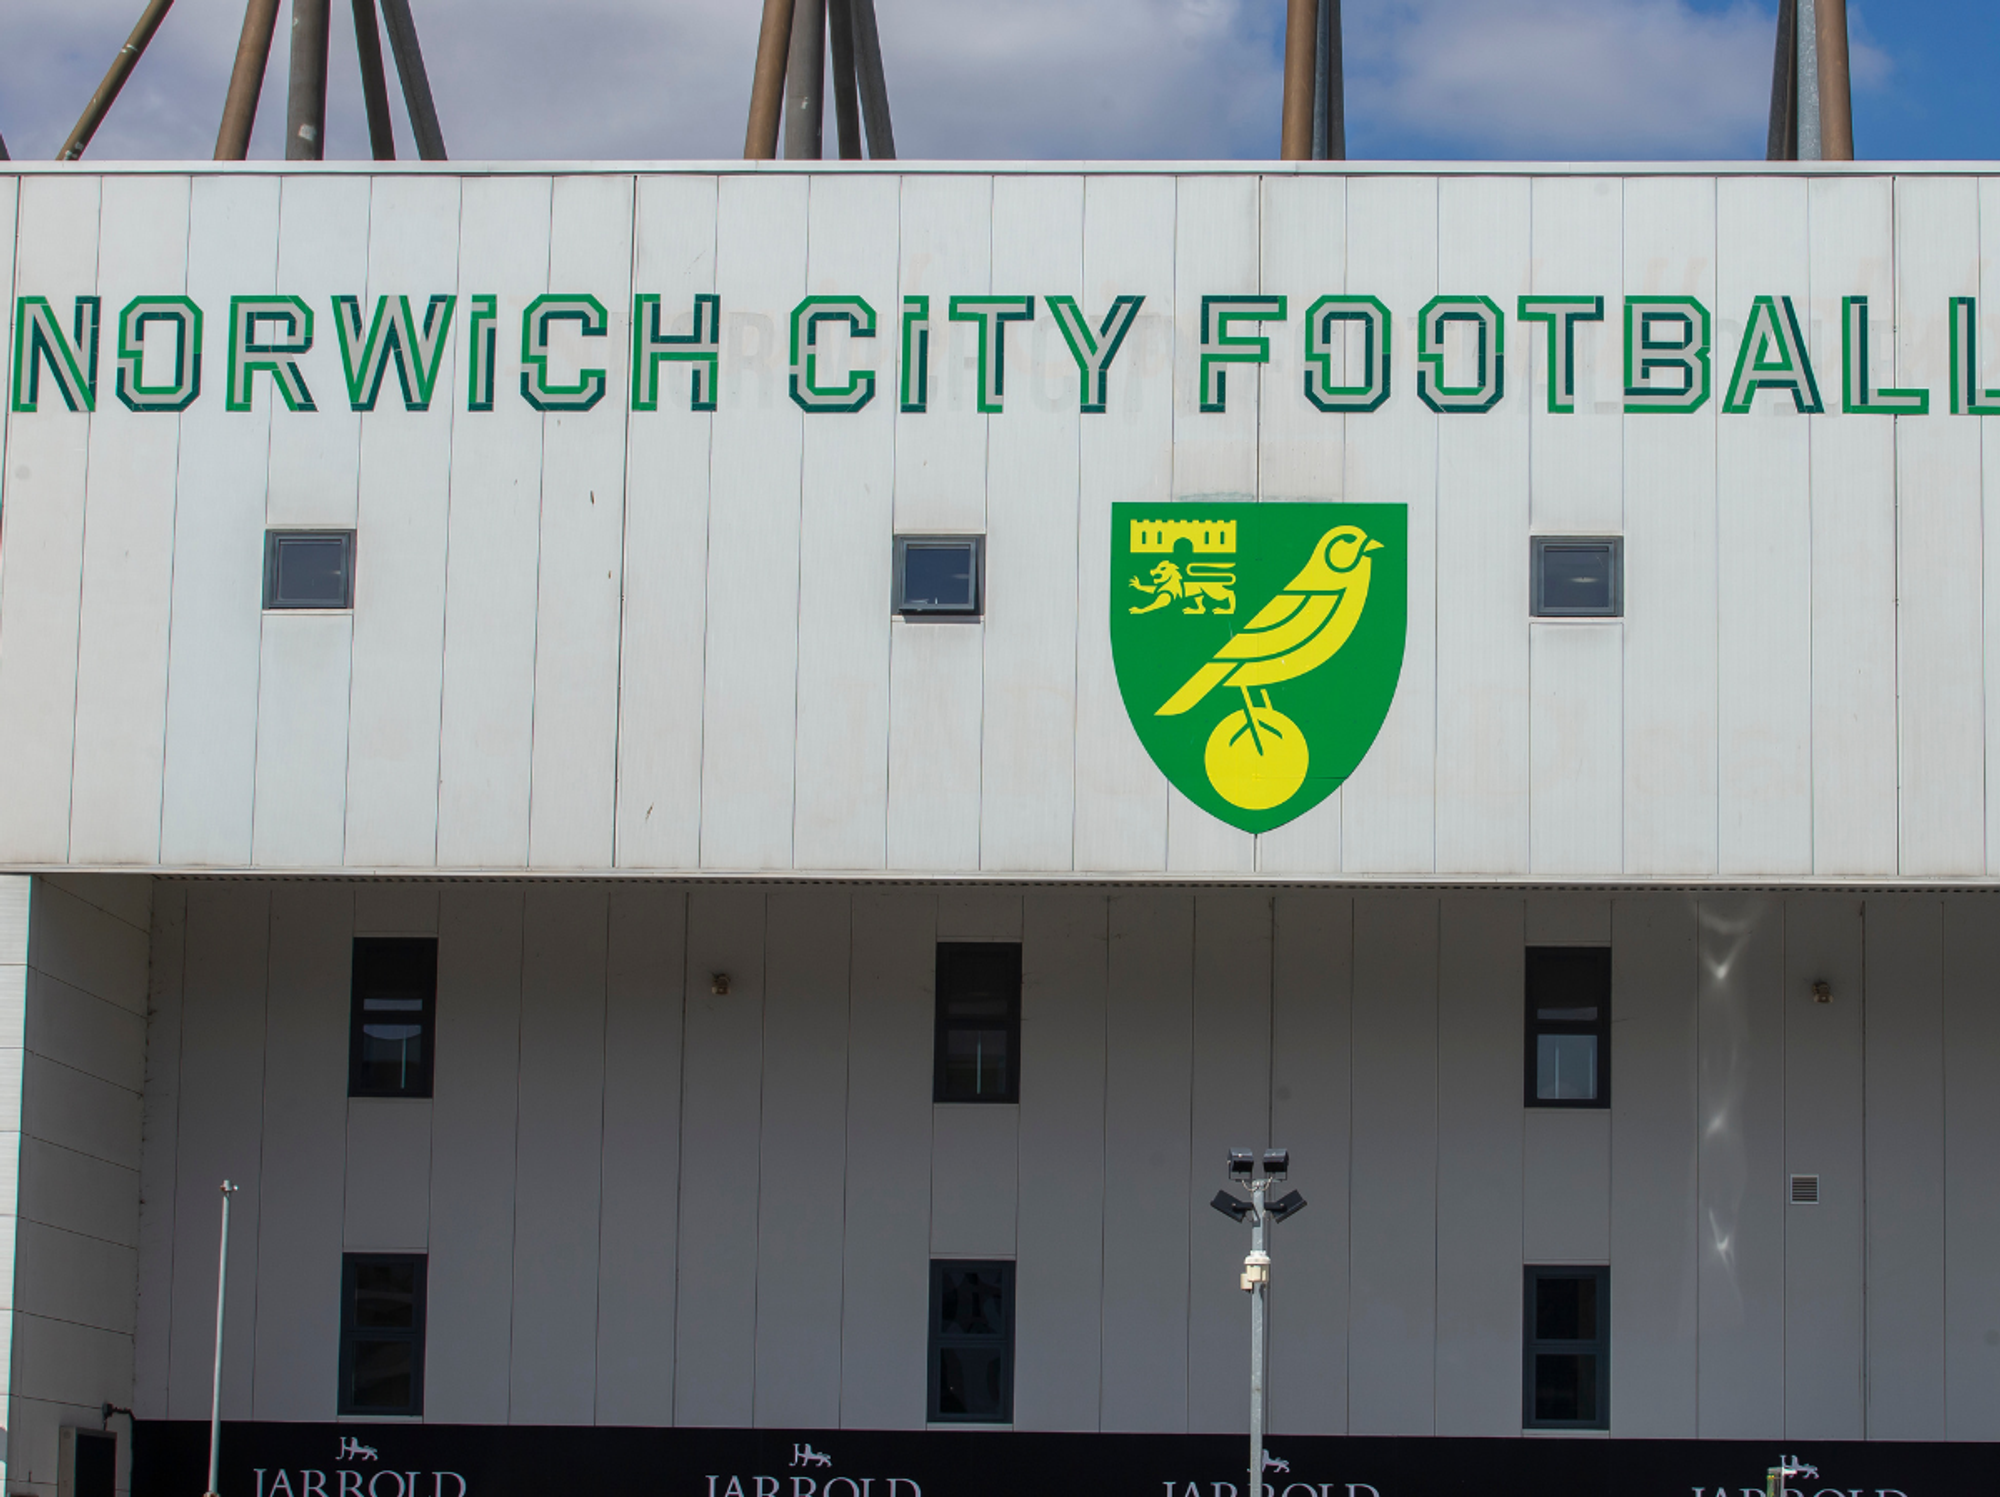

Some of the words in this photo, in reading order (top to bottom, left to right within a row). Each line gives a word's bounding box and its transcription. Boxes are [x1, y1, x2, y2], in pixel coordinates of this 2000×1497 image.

[12, 294, 719, 411] NORWICH
[789, 295, 1144, 412] CITY
[1200, 294, 2000, 415] FOOTBALL
